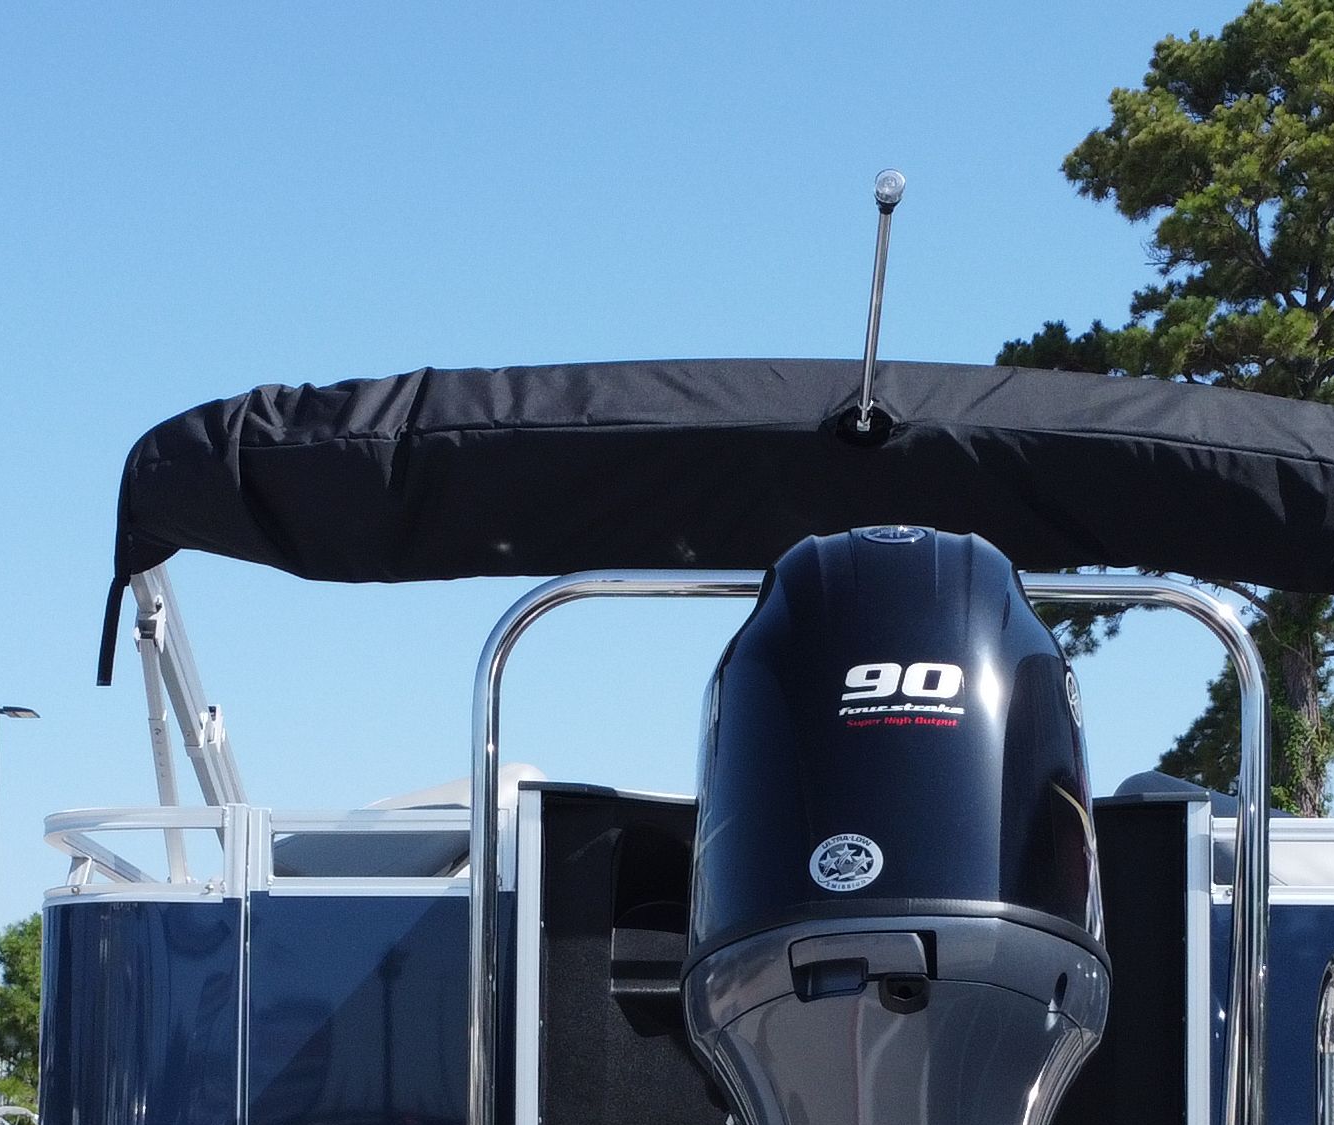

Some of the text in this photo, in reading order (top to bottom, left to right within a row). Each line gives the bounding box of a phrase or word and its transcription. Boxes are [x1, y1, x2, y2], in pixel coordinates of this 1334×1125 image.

[841, 662, 963, 701] 90
[846, 716, 959, 727] Super High Output
